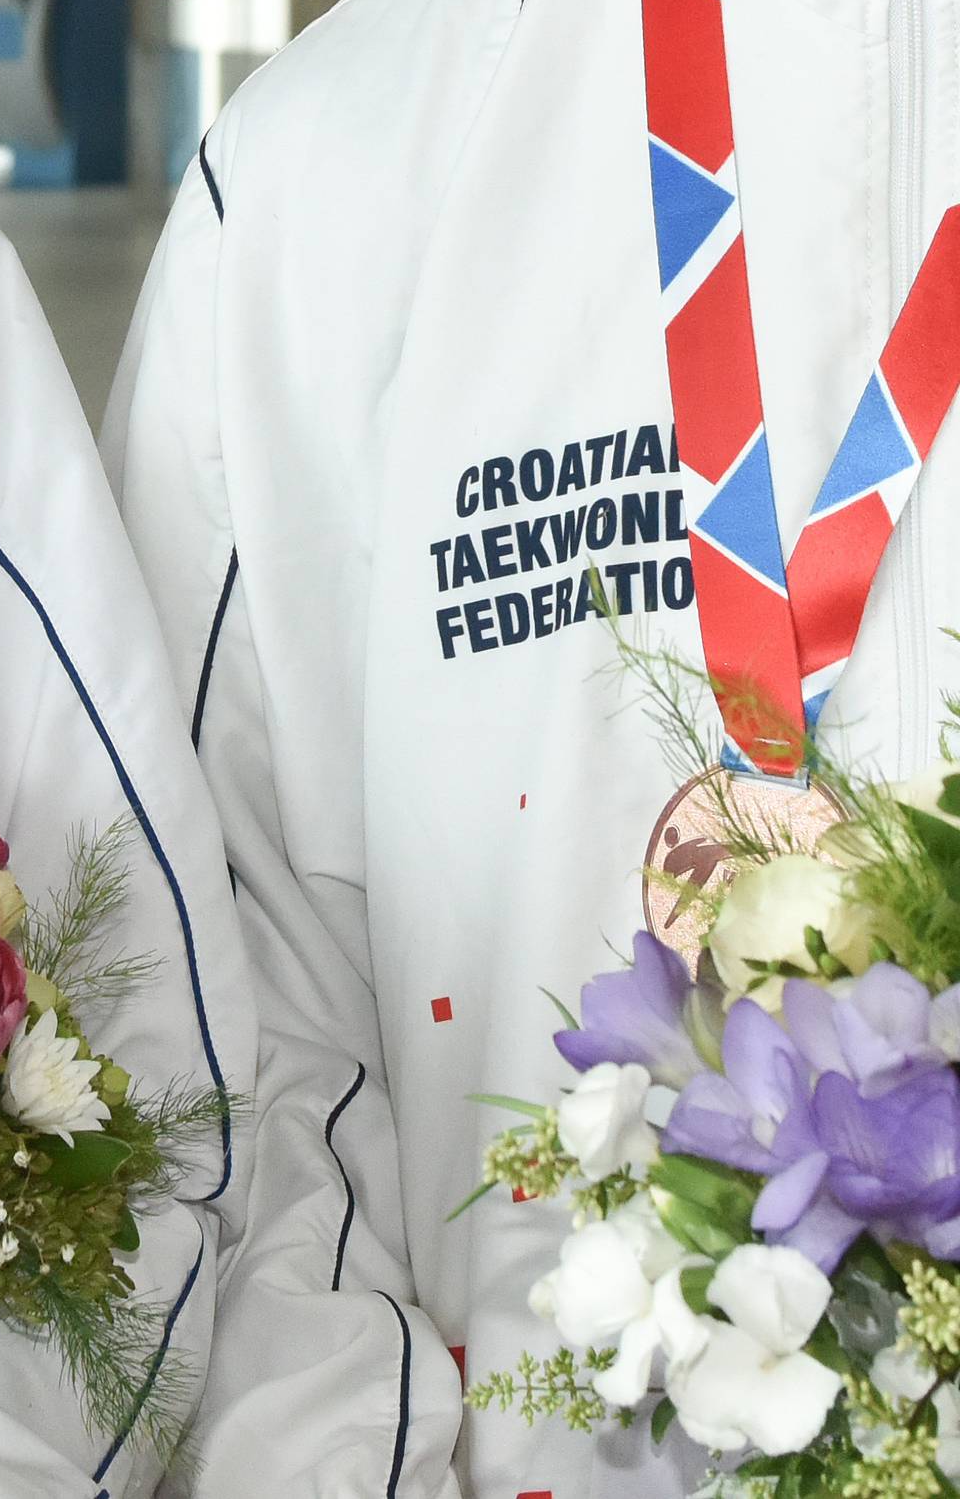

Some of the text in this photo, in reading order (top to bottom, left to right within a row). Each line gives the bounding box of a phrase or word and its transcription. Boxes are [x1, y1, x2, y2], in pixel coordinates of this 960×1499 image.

[456, 423, 681, 519] CROATIA
[430, 489, 689, 592] TAEKWOND
[436, 556, 695, 660] FEDERATIO
